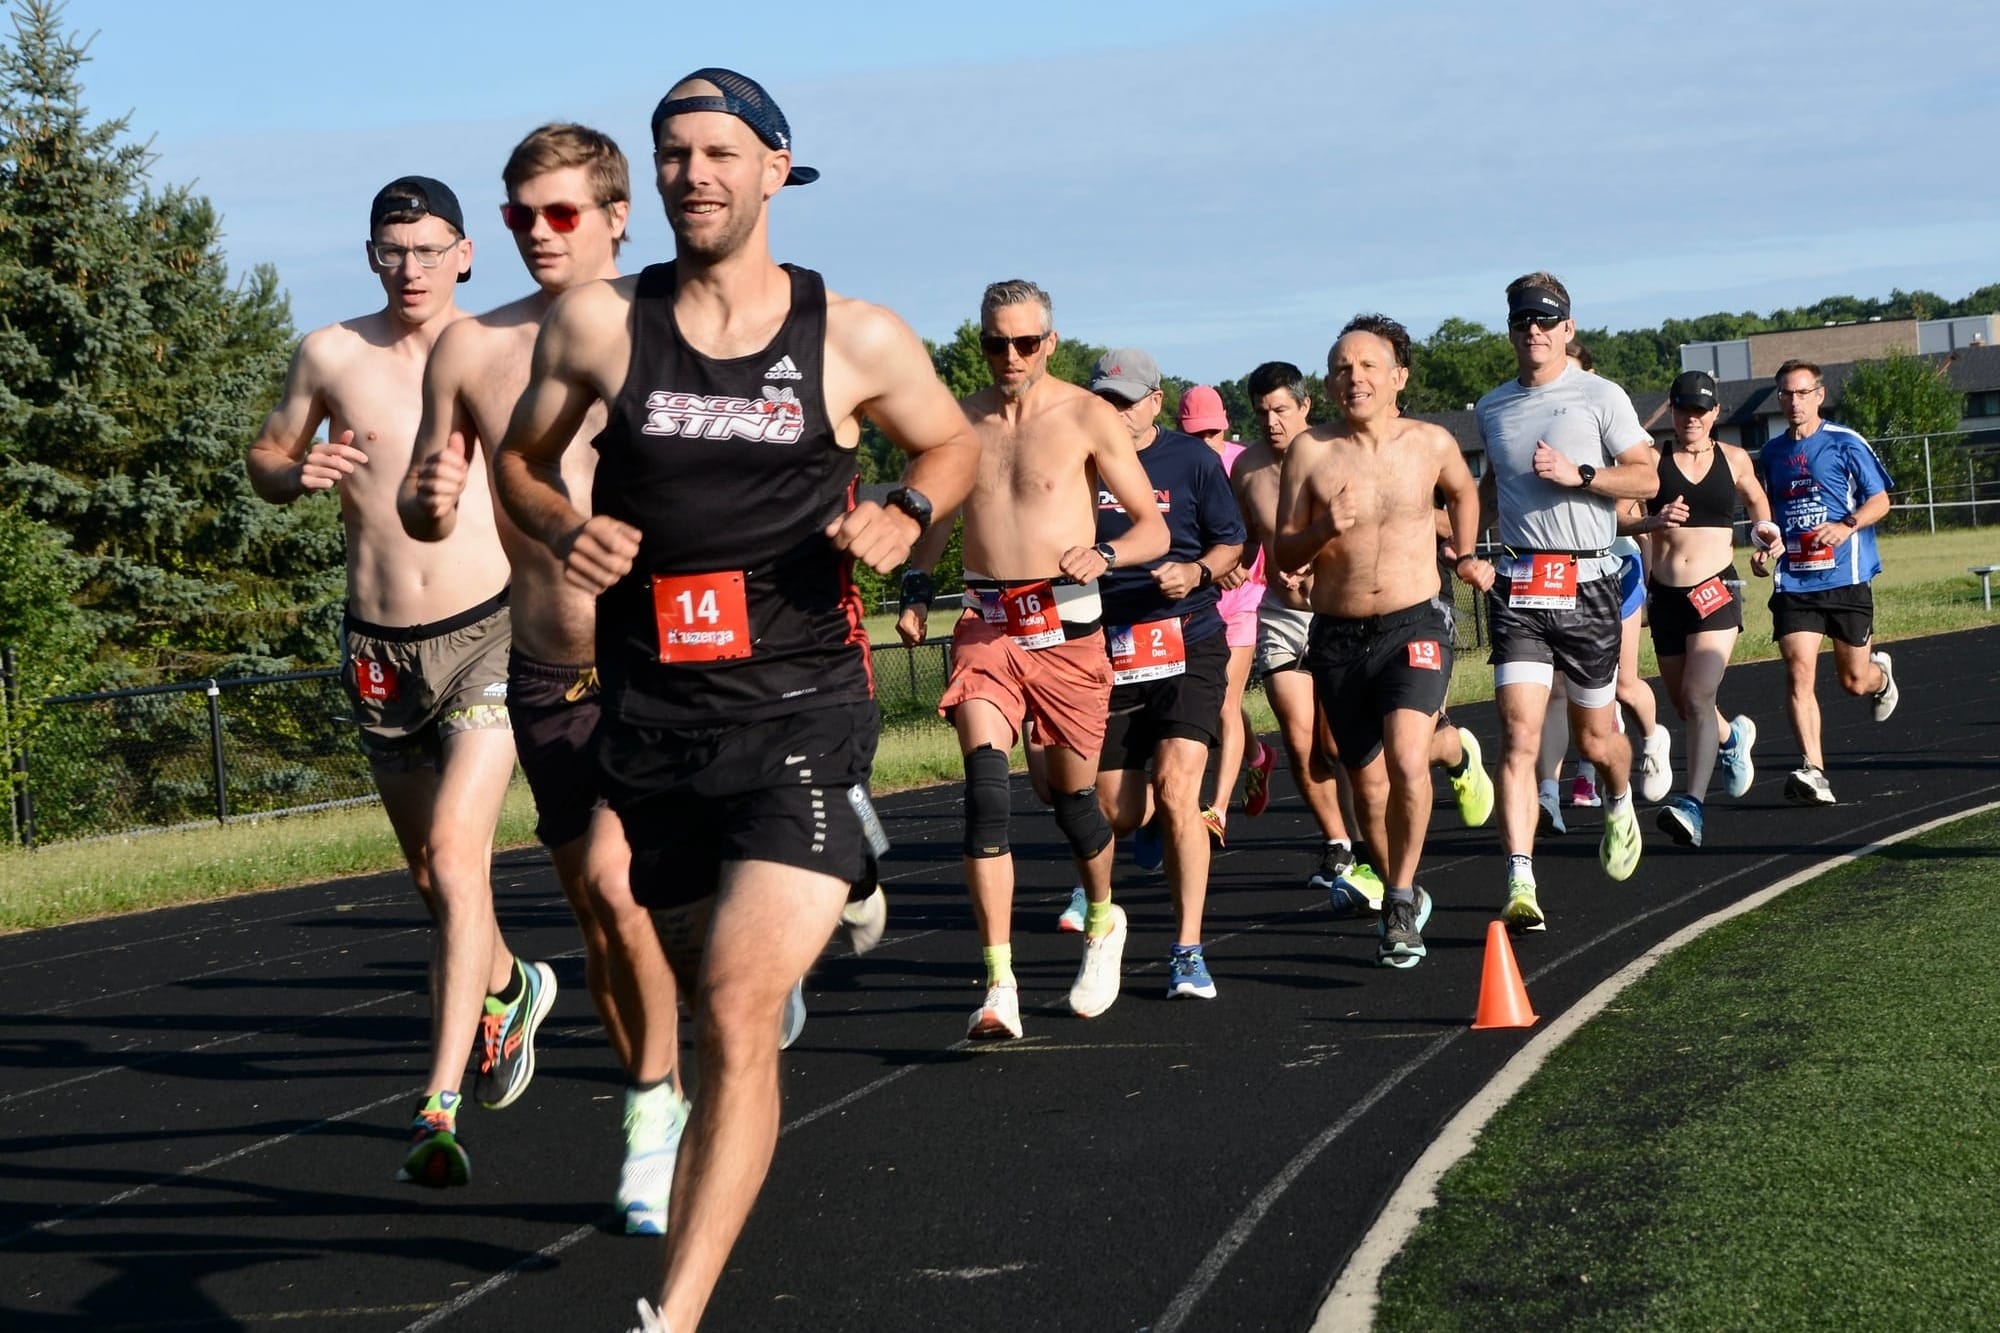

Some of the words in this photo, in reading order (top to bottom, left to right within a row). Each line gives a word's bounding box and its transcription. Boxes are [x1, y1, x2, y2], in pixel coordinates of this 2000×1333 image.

[764, 371, 803, 380] adidas
[645, 391, 766, 413] SENECA
[642, 408, 804, 444] STING
[1544, 562, 1565, 580] 12
[1695, 585, 1719, 604] 101
[676, 589, 720, 625] 14
[1015, 594, 1041, 616] 16
[1150, 628, 1164, 647] 2
[1412, 642, 1434, 657] 13
[368, 662, 384, 683] 8
